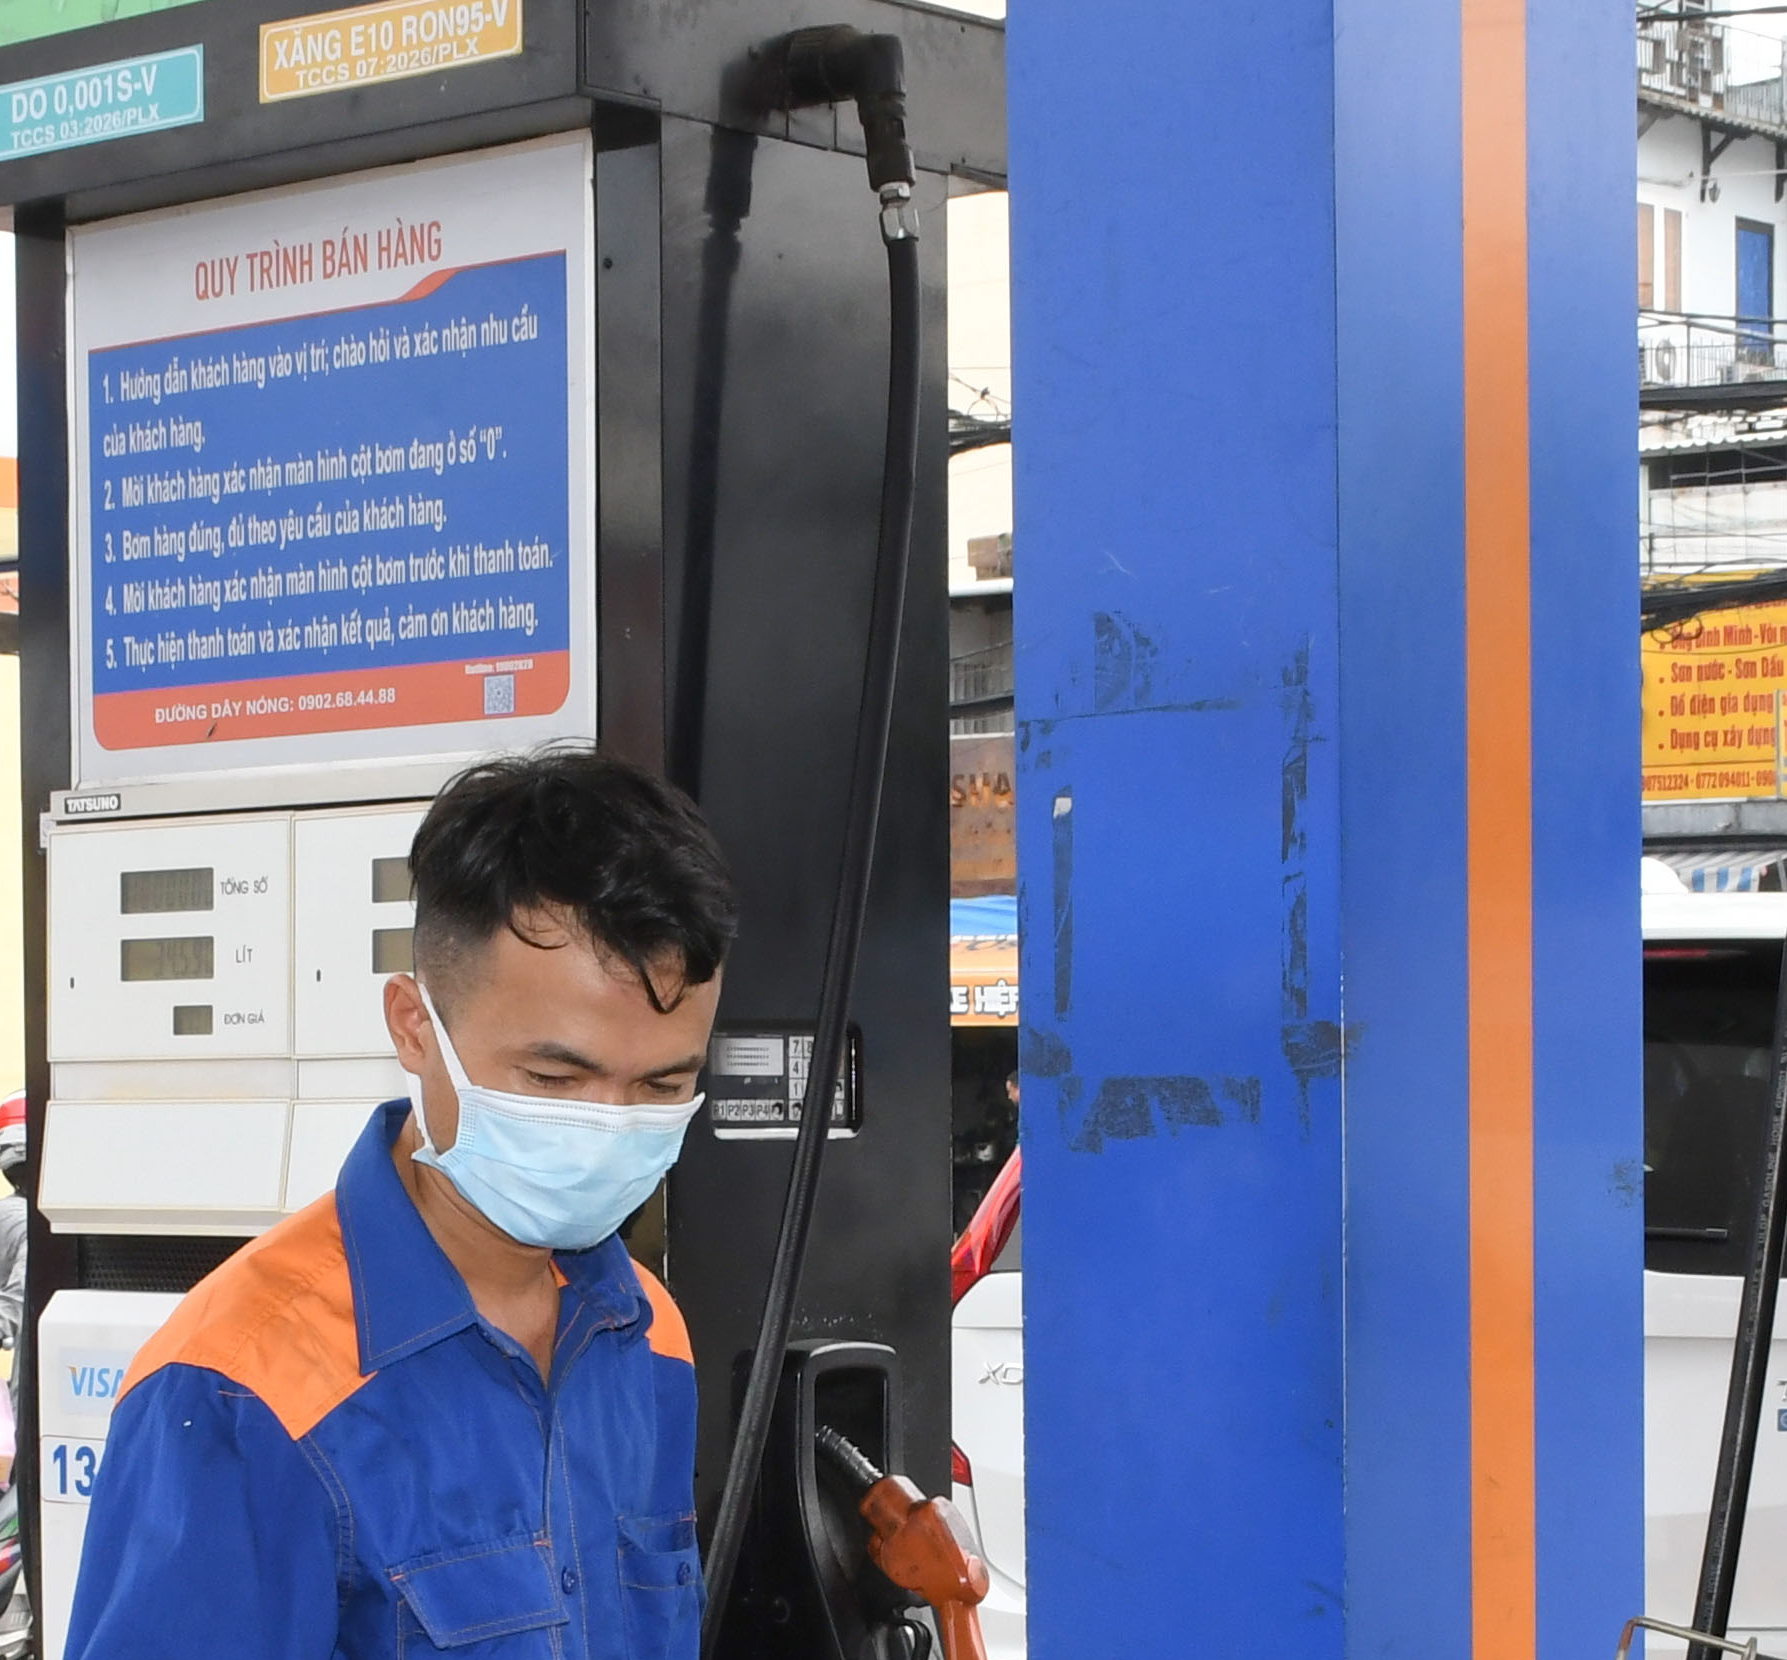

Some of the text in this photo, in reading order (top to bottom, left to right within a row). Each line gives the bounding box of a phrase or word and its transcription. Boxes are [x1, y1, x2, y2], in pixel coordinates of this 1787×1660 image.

[274, 0, 510, 71] XĂNG E10 RON95-V
[295, 37, 480, 89] TCCS 07:2026/PLX
[12, 64, 158, 124] DO 0,001S-V
[10, 103, 160, 150] TCCS 03:2026/PLX
[194, 217, 443, 300] QUY TRÌNH BÁN HÀNG
[102, 376, 114, 404] 1.
[190, 353, 230, 389] khách
[232, 347, 265, 389] hàng
[268, 344, 293, 379] vào
[332, 334, 367, 369] chào
[369, 329, 391, 364] hỏi
[394, 323, 411, 359] và
[413, 319, 440, 356] xác
[442, 315, 478, 358] nhận
[480, 311, 509, 349] nhu
[103, 415, 206, 457] của khách hàng.
[104, 479, 116, 510] 2.
[147, 469, 185, 504] khách
[188, 466, 220, 504] hàng
[223, 461, 246, 495] xác
[249, 456, 282, 496] nhận
[285, 452, 314, 486] màn
[317, 447, 348, 482] hình
[375, 442, 405, 474] bơm
[408, 437, 444, 476] đang
[459, 424, 477, 464] số
[105, 533, 116, 563] 3.
[154, 524, 186, 562] hàng
[248, 513, 277, 546] theo
[279, 508, 304, 550] yêu
[335, 499, 359, 535] của
[362, 495, 405, 532] khách
[408, 491, 448, 533] hàng.
[105, 585, 117, 616] 4.
[148, 574, 185, 611] khách
[188, 573, 221, 612] hàng
[224, 569, 247, 604] xác
[250, 565, 283, 606] nhận
[286, 562, 315, 597] màn
[318, 558, 348, 592] hình
[376, 553, 406, 586] bơm
[448, 544, 471, 579] khi
[474, 538, 514, 576] thanh
[518, 534, 553, 571] toán.
[106, 638, 118, 669] 5.
[157, 630, 185, 671] hiện
[188, 626, 225, 661] thanh
[228, 623, 256, 658] toán
[259, 620, 274, 653] và
[277, 618, 301, 651] xác
[304, 614, 338, 656] nhận
[452, 598, 495, 635] khách
[499, 595, 539, 636] hàng.
[154, 687, 396, 724] ĐƯỜNG DÂY NÓNG: 0902.68.44.88
[66, 795, 119, 813] TATSUNO
[220, 876, 249, 895] TỔNG
[253, 875, 268, 894] SỐ
[235, 944, 253, 964] LÍT
[224, 1010, 265, 1026] ĐƠN GIÁ
[53, 1444, 97, 1497] 13
